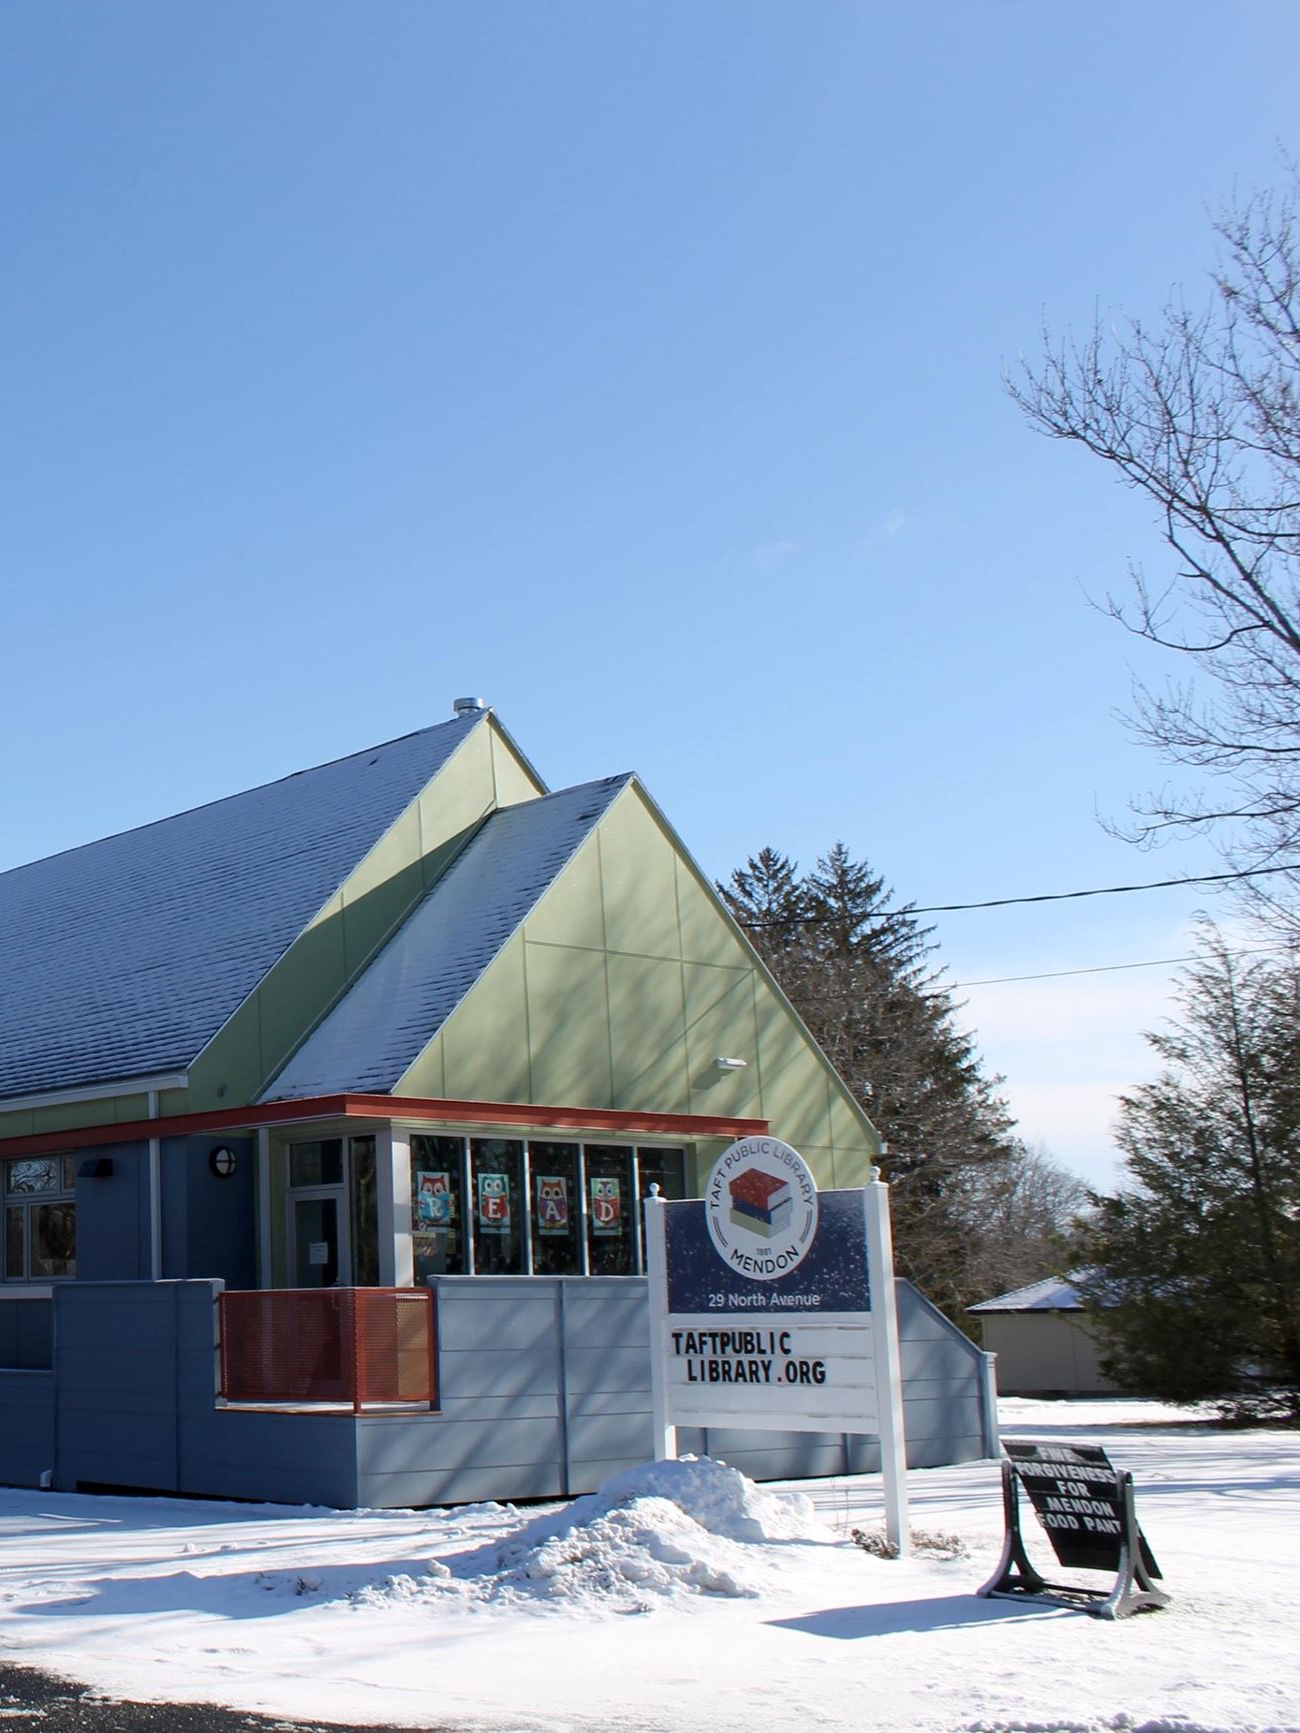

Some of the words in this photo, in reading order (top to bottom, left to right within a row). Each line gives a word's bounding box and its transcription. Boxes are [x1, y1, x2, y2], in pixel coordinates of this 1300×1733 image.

[710, 1168, 727, 1210] TAFT
[724, 1142, 770, 1169] PUBLIC
[773, 1146, 814, 1206] LIBRARY
[730, 1245, 800, 1274] MENDON
[708, 1294, 725, 1308] 29
[728, 1292, 766, 1307] North
[769, 1292, 821, 1306] Avenue
[1015, 1462, 1117, 1484] FORGIVENESS
[1056, 1480, 1092, 1498] FOR
[1046, 1496, 1116, 1518] MENDON
[1036, 1512, 1080, 1530] FOOD
